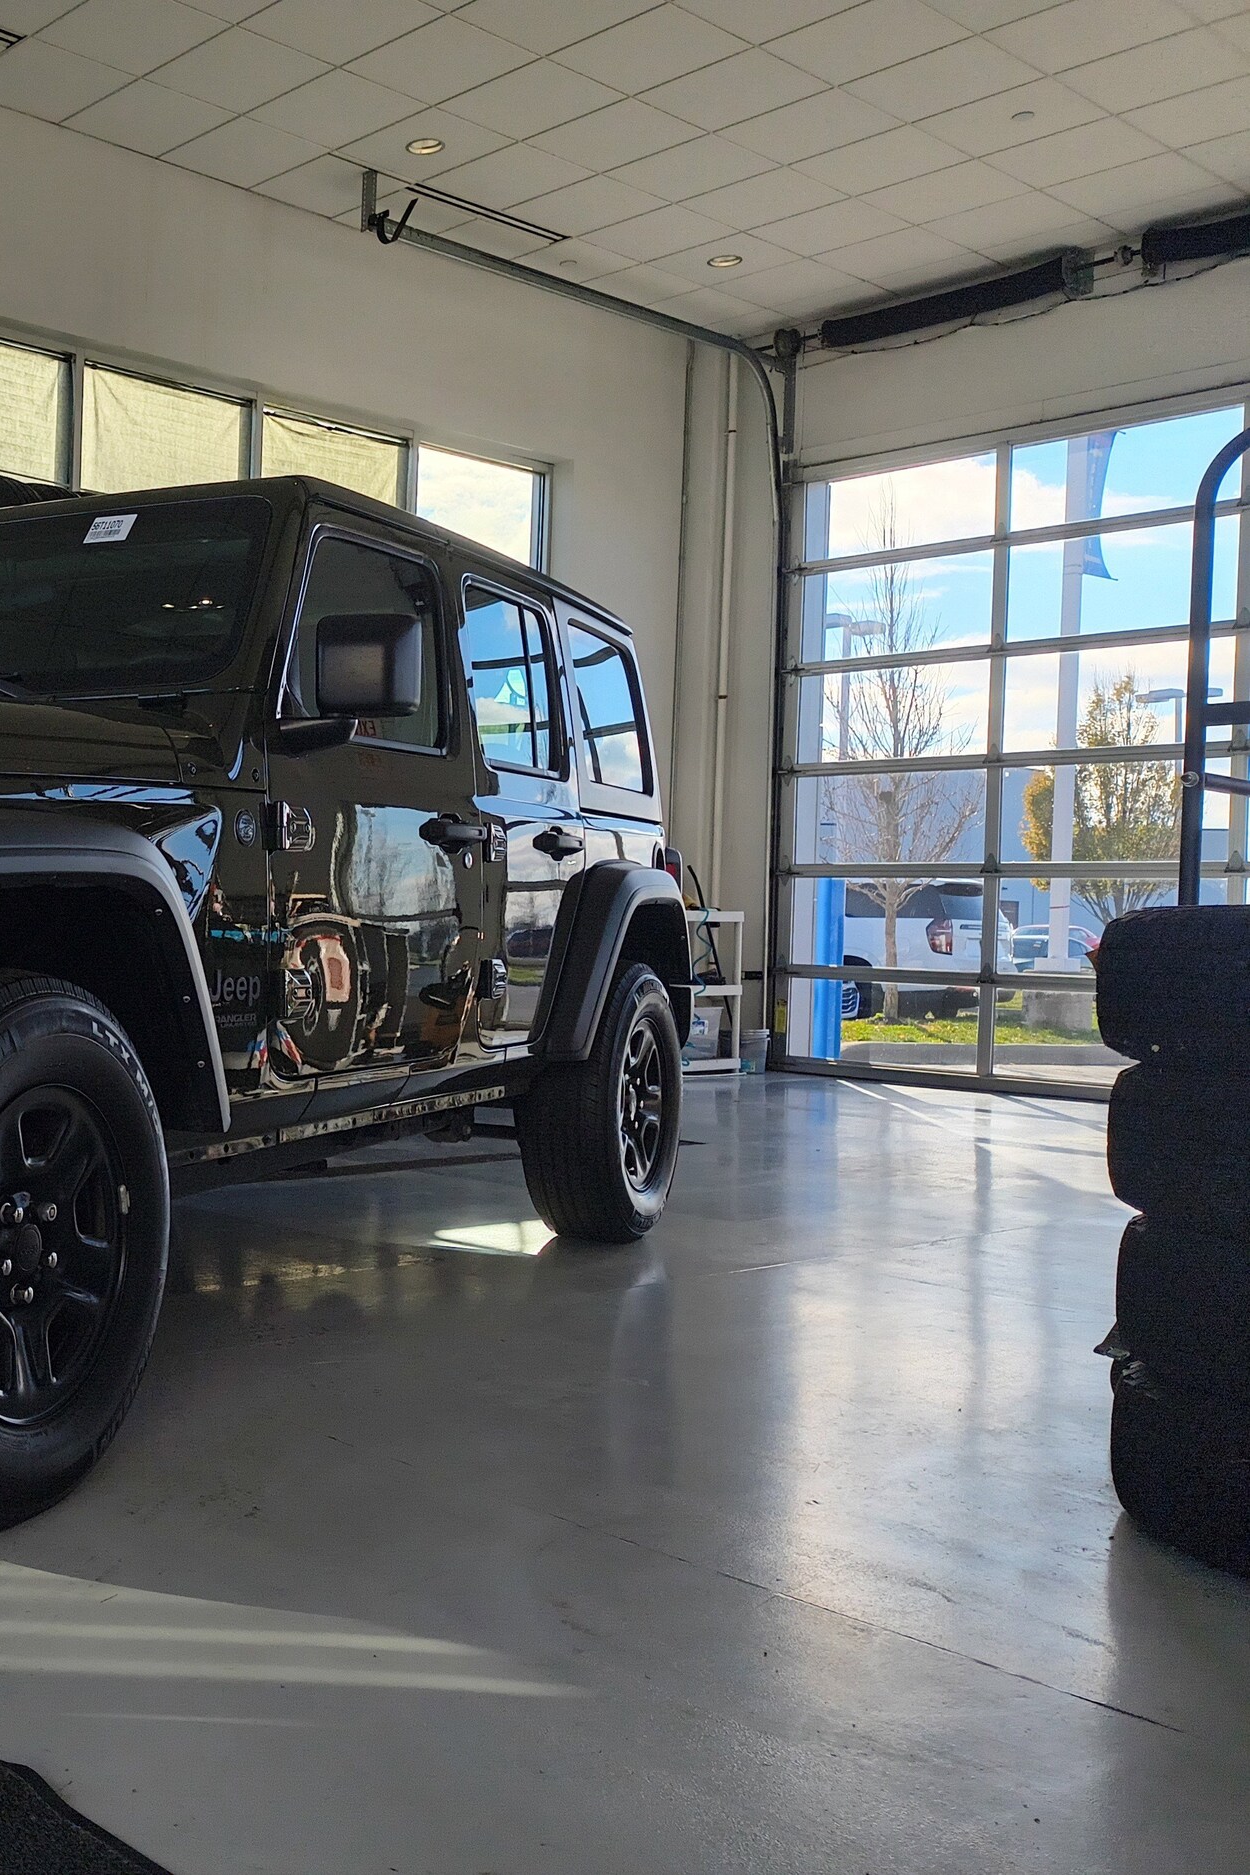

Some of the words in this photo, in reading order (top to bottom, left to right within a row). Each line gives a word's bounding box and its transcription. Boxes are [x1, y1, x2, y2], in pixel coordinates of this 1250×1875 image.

[208, 969, 261, 1007] Jeep
[214, 1013, 257, 1024] RANGLER
[91, 1020, 131, 1067] LTX
